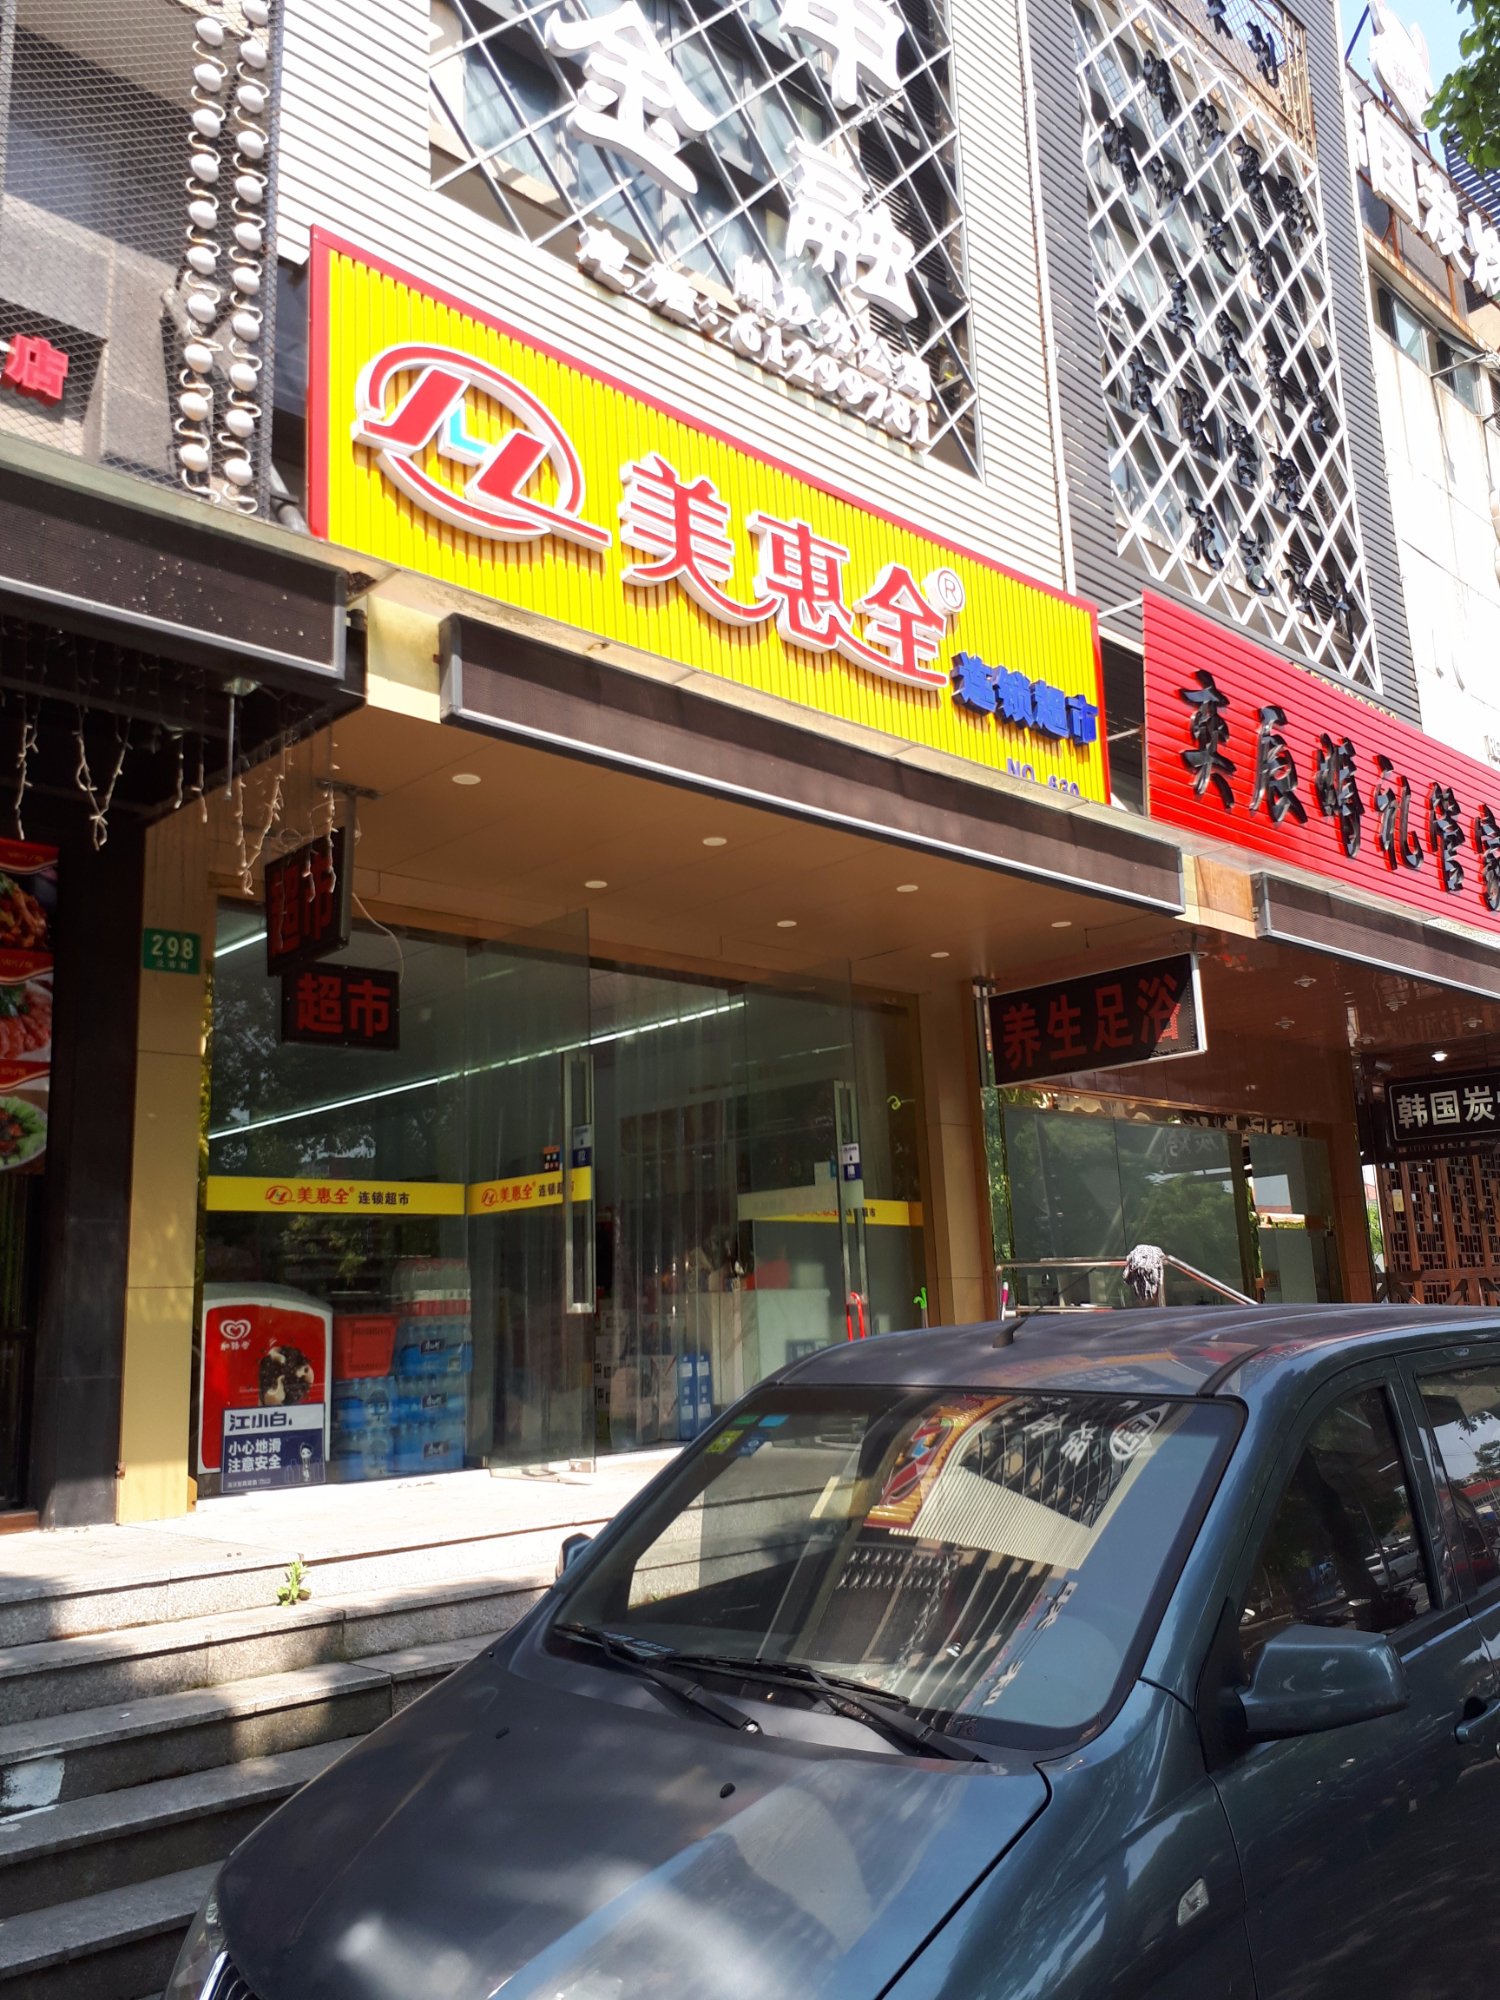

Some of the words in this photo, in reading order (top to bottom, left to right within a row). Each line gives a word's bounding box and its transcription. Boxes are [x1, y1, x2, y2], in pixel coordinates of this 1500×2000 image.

[545, 2, 918, 322] 金融
[619, 451, 948, 691] 美惠全
[950, 652, 1099, 746] 连锁超市
[151, 934, 193, 960] 298
[297, 972, 392, 1036] 超市
[1002, 973, 1182, 1071] 养生足浴
[1396, 1085, 1500, 1129] 韩国炭
[297, 1186, 349, 1206] 美惠全
[358, 1191, 410, 1206] 连锁超市
[227, 1454, 282, 1474] 注意安全
[228, 1437, 282, 1457] 小心地滑
